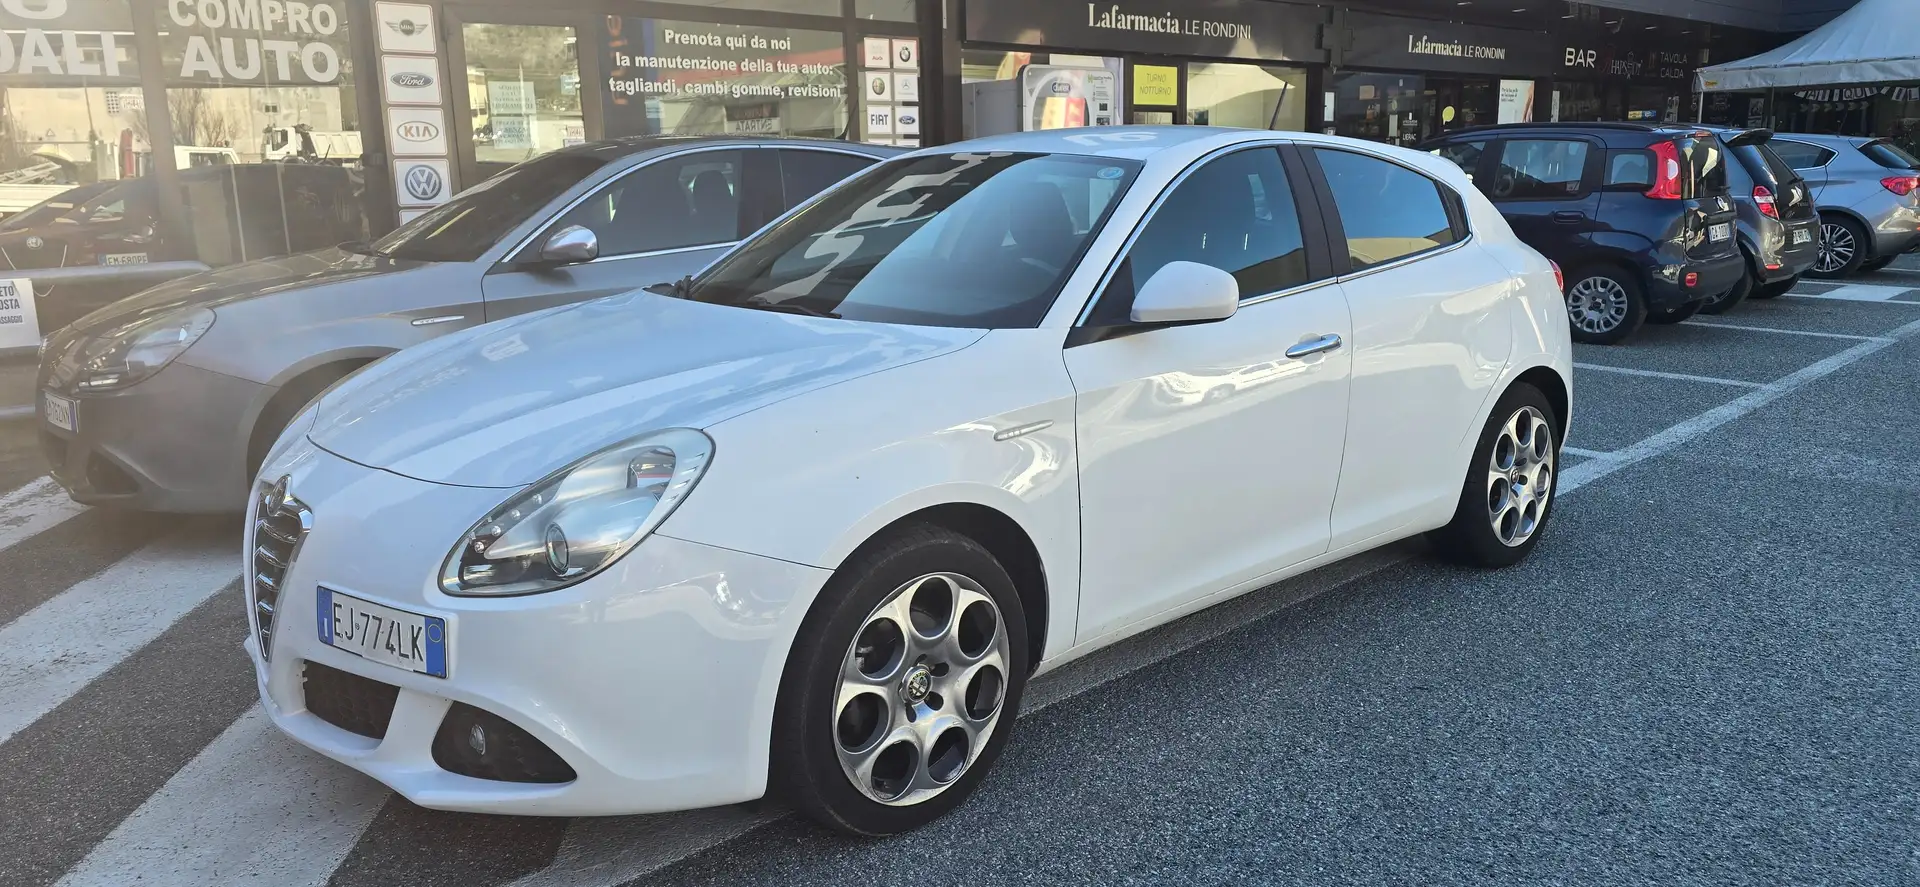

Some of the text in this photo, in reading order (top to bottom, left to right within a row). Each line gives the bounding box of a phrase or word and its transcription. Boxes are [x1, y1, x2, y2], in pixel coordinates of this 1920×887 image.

[169, 0, 338, 35] COMPRO
[664, 29, 791, 51] Prenota qui da noi
[1203, 20, 1251, 40] RONDINI
[1408, 34, 1462, 57] Lafarmacia
[1475, 46, 1506, 60] RONDINI
[180, 36, 339, 83] AUTO
[615, 52, 834, 76] la manutenzione della tua auto:
[1564, 47, 1597, 69] BAR
[1660, 51, 1688, 64] TAVOLA
[400, 73, 425, 87] Ford
[1146, 73, 1167, 83] TURNO
[1660, 67, 1685, 79] CALDA
[608, 77, 841, 99] tagliandi, cambi gomme, revisioni
[1140, 86, 1172, 96] NOTTURNO
[870, 114, 889, 126] FIAT
[404, 125, 433, 138] KIA
